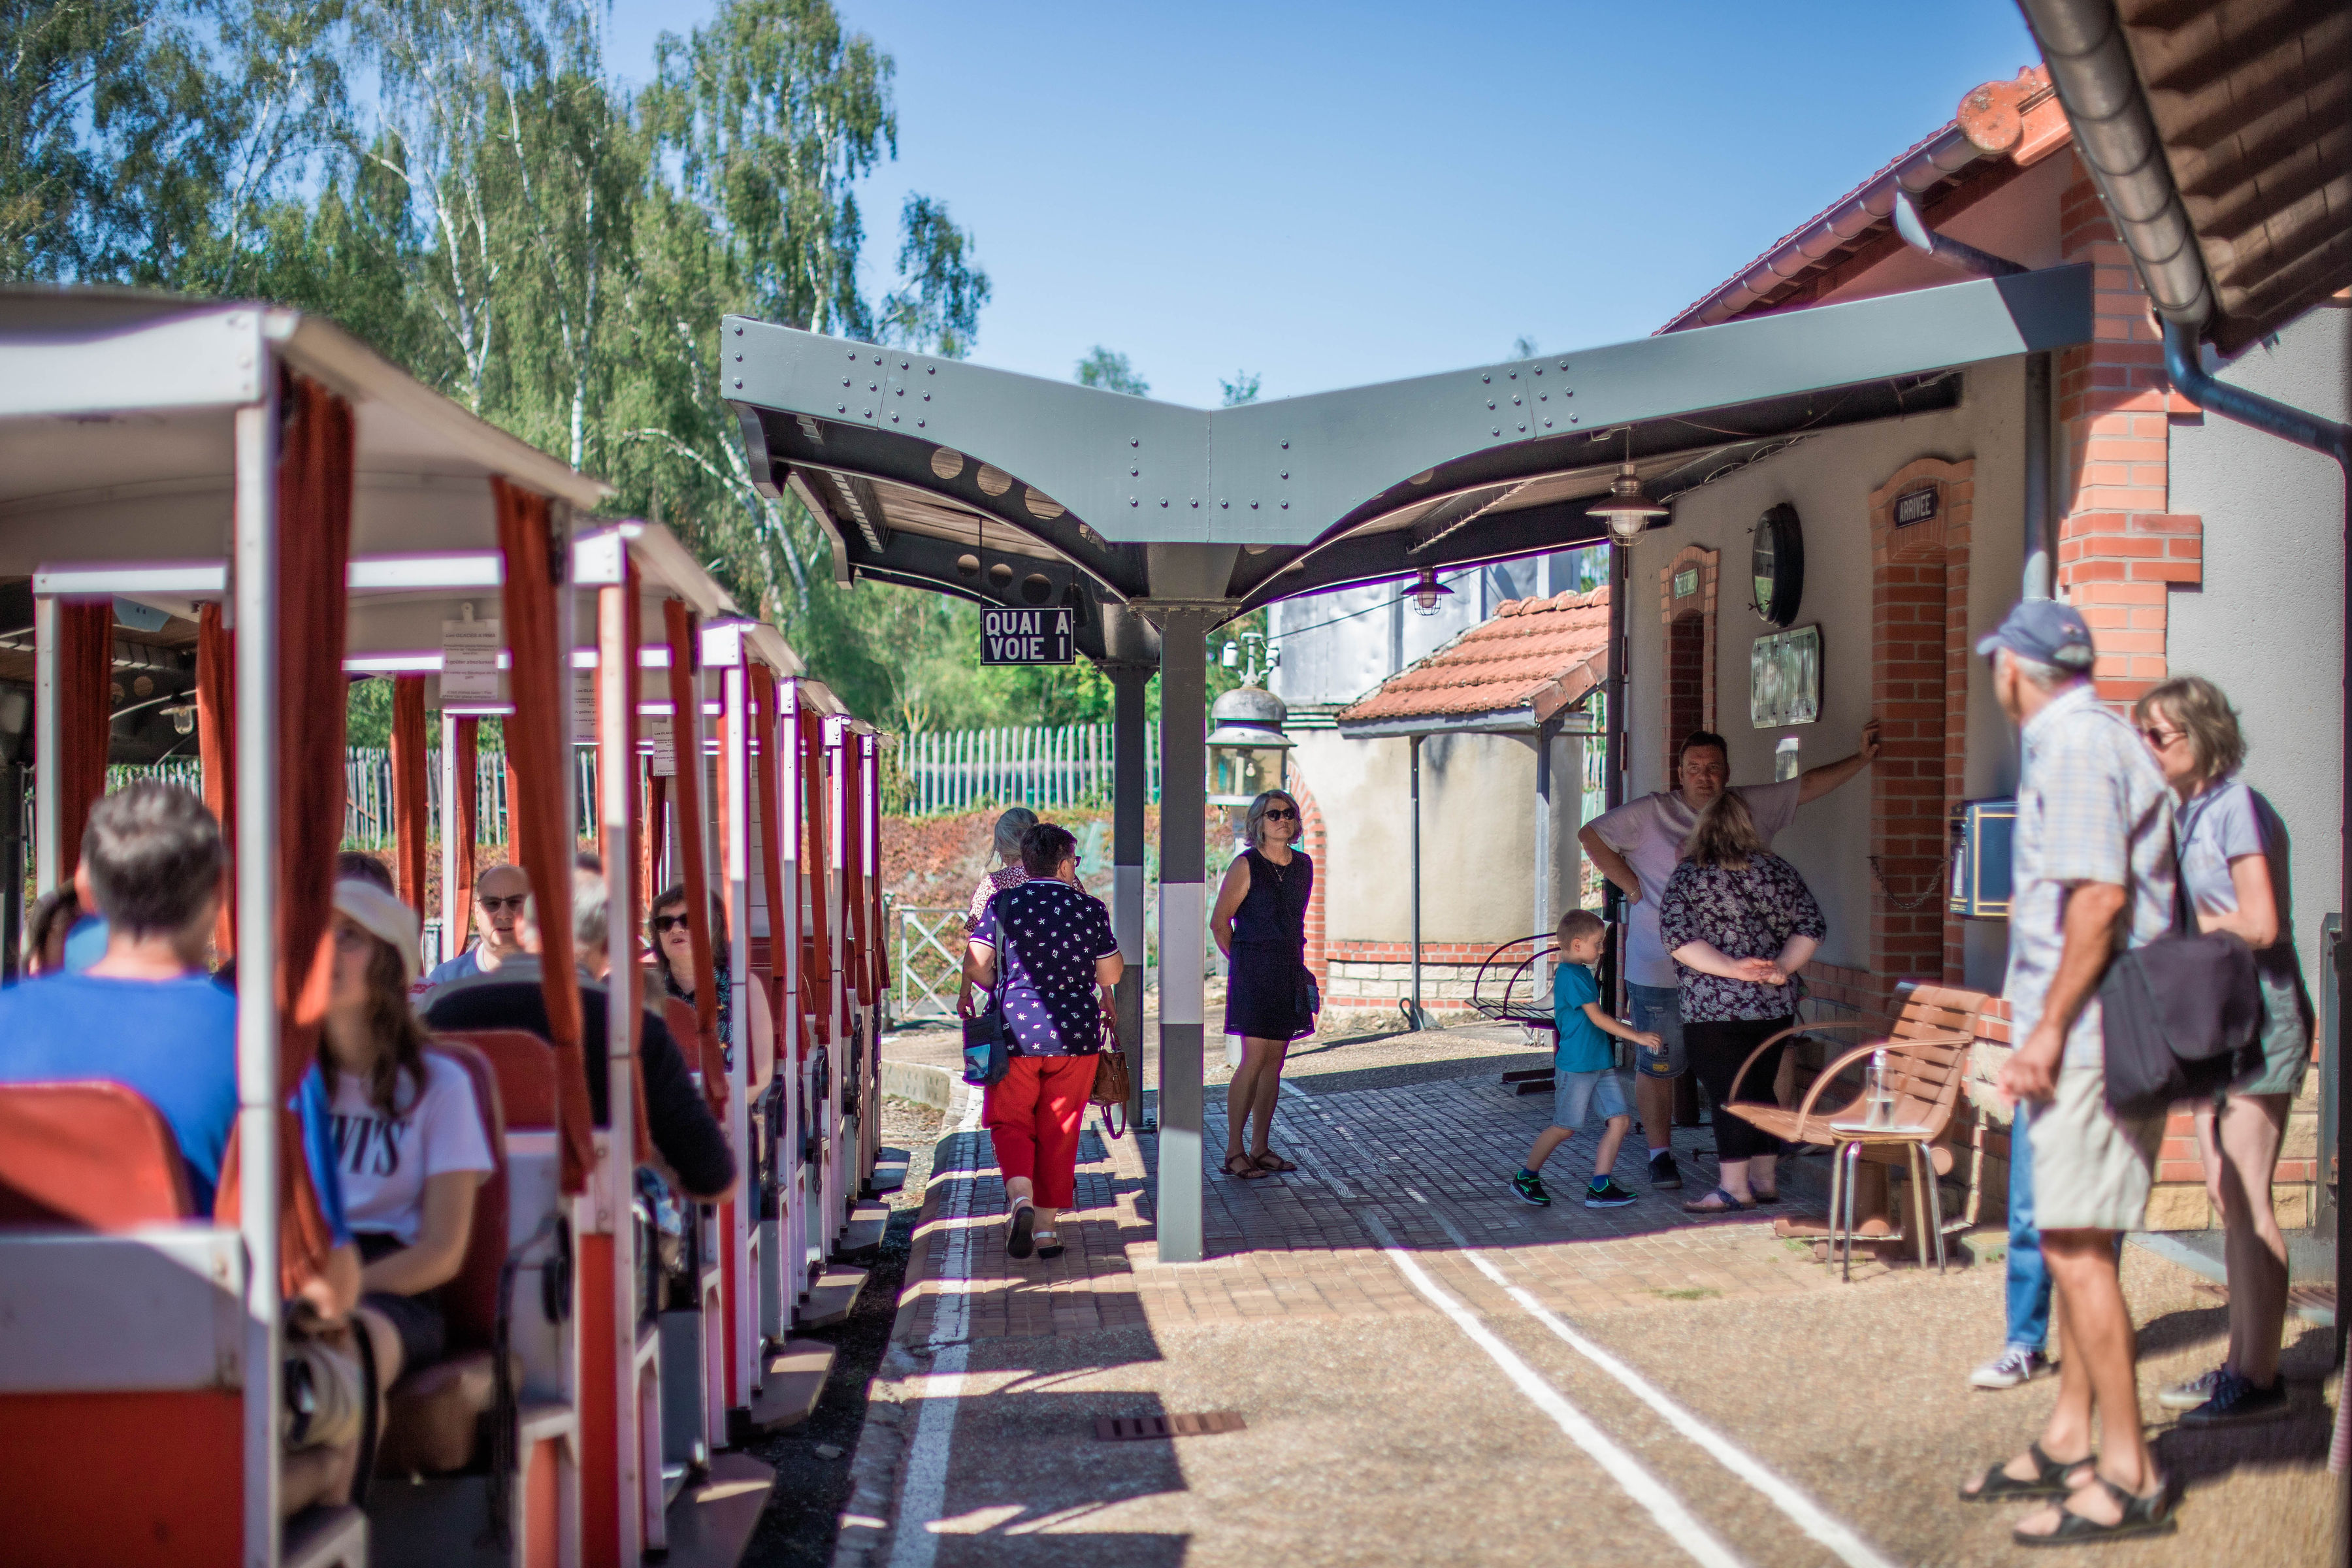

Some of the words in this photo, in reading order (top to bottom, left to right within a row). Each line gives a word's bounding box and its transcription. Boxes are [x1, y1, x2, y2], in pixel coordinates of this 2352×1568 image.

[986, 612, 1040, 637] QUAI
[1055, 612, 1070, 634] A
[990, 637, 1045, 660] VOIE
